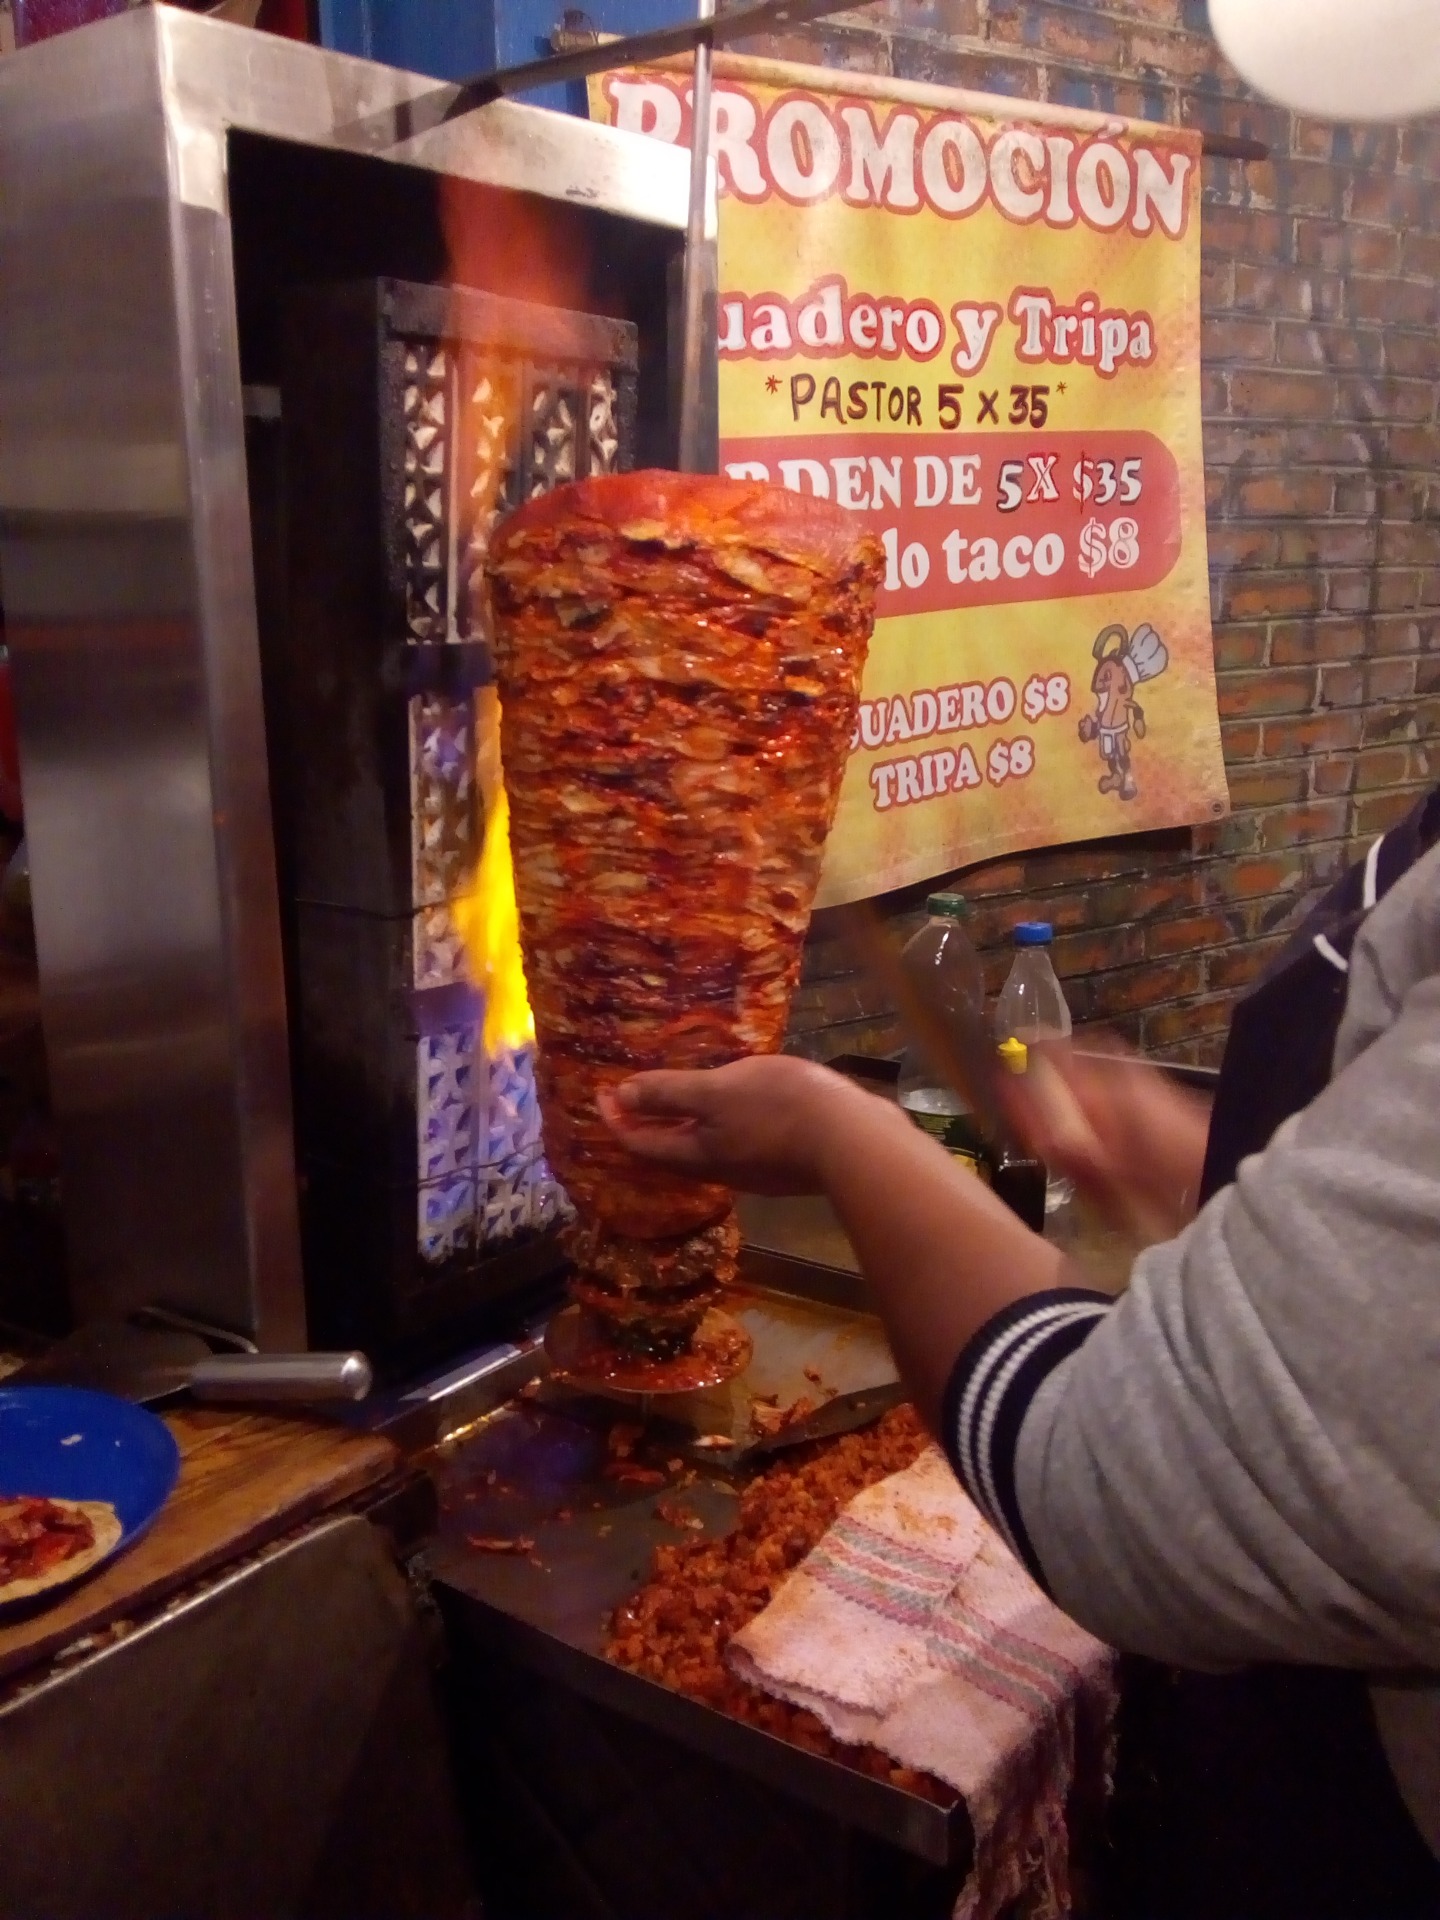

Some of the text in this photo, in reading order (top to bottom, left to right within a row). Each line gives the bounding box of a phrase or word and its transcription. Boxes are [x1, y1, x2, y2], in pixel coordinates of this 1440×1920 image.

[607, 76, 1190, 236] PROMOCIÓN
[955, 308, 999, 370] y
[1014, 295, 1152, 372] Tripa
[790, 373, 923, 424] PASTOR
[938, 383, 964, 430] 5
[1008, 384, 1050, 428] 35
[913, 454, 982, 507] DE
[1072, 450, 1143, 514] $35
[942, 528, 1065, 584] taco
[1078, 516, 1140, 579] $8
[851, 675, 1069, 749] UADERO $8
[871, 739, 1033, 808] TRIPA $8
